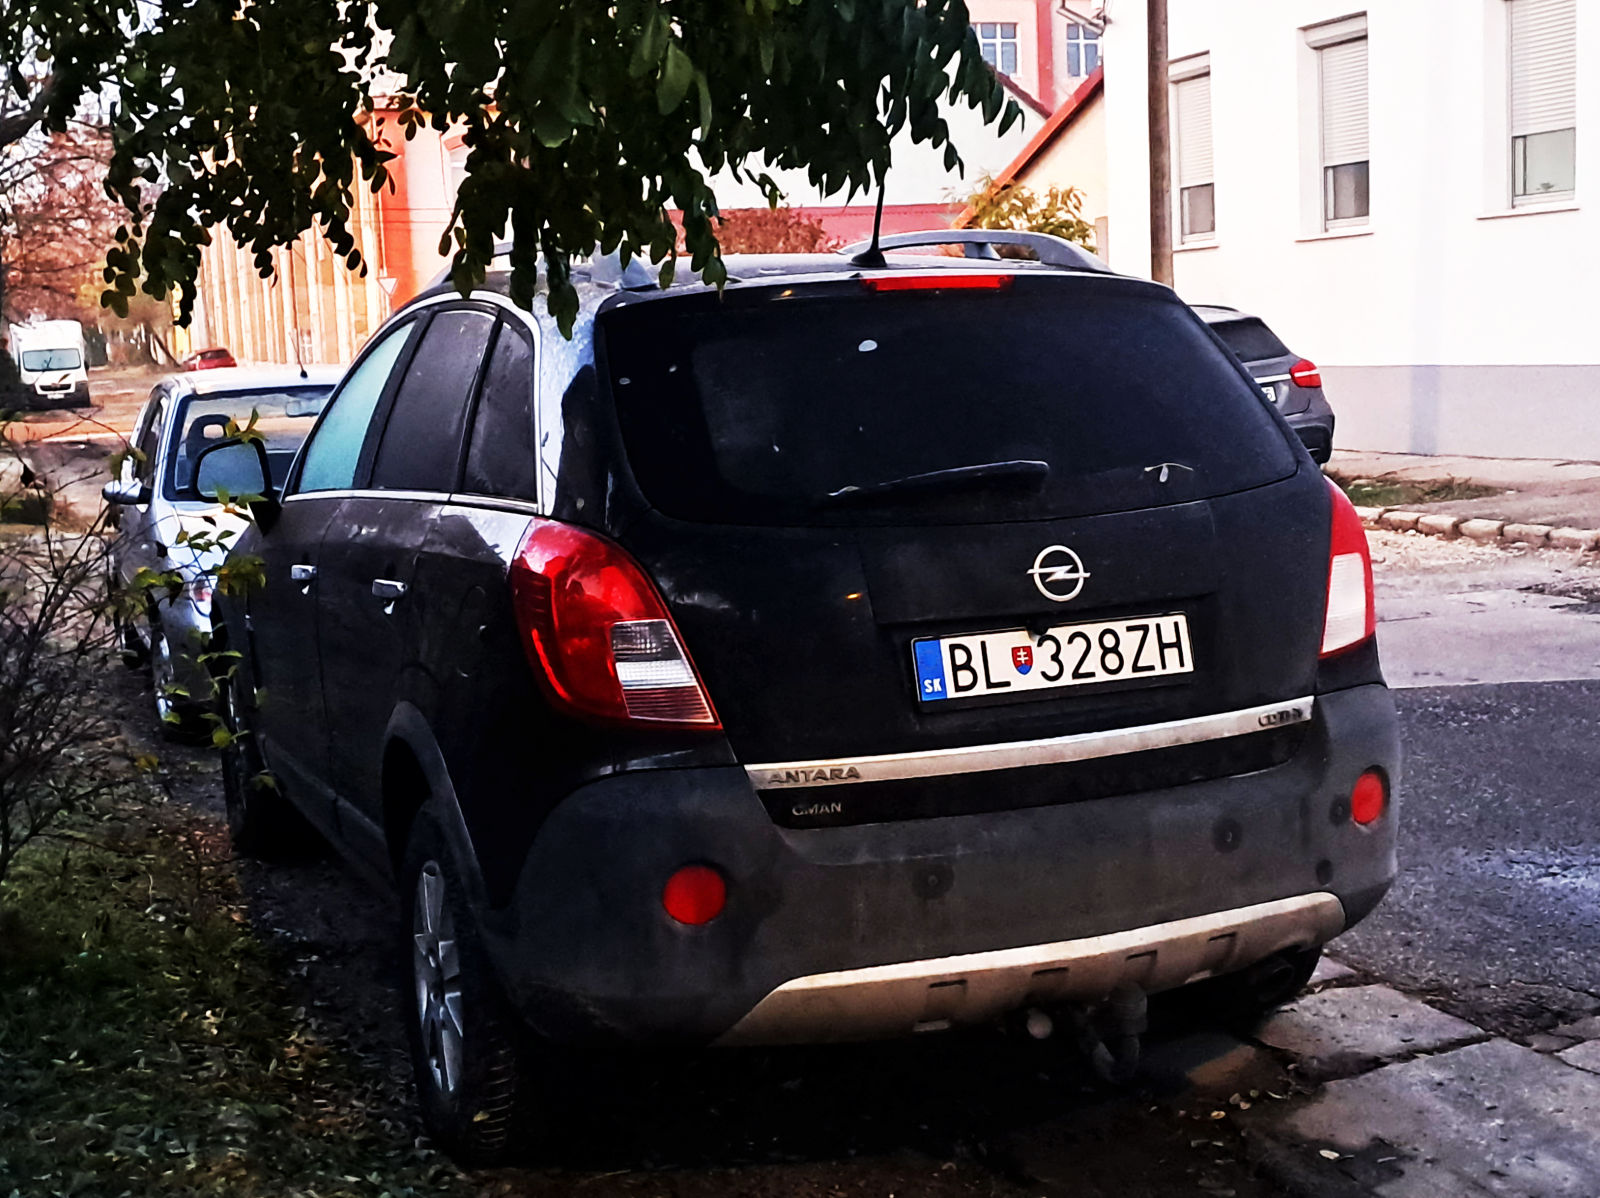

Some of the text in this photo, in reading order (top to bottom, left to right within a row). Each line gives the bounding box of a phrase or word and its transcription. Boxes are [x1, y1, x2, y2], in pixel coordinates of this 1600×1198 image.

[949, 621, 1185, 693] BL 328ZH
[923, 678, 943, 693] SK
[768, 766, 861, 784] ANTARA
